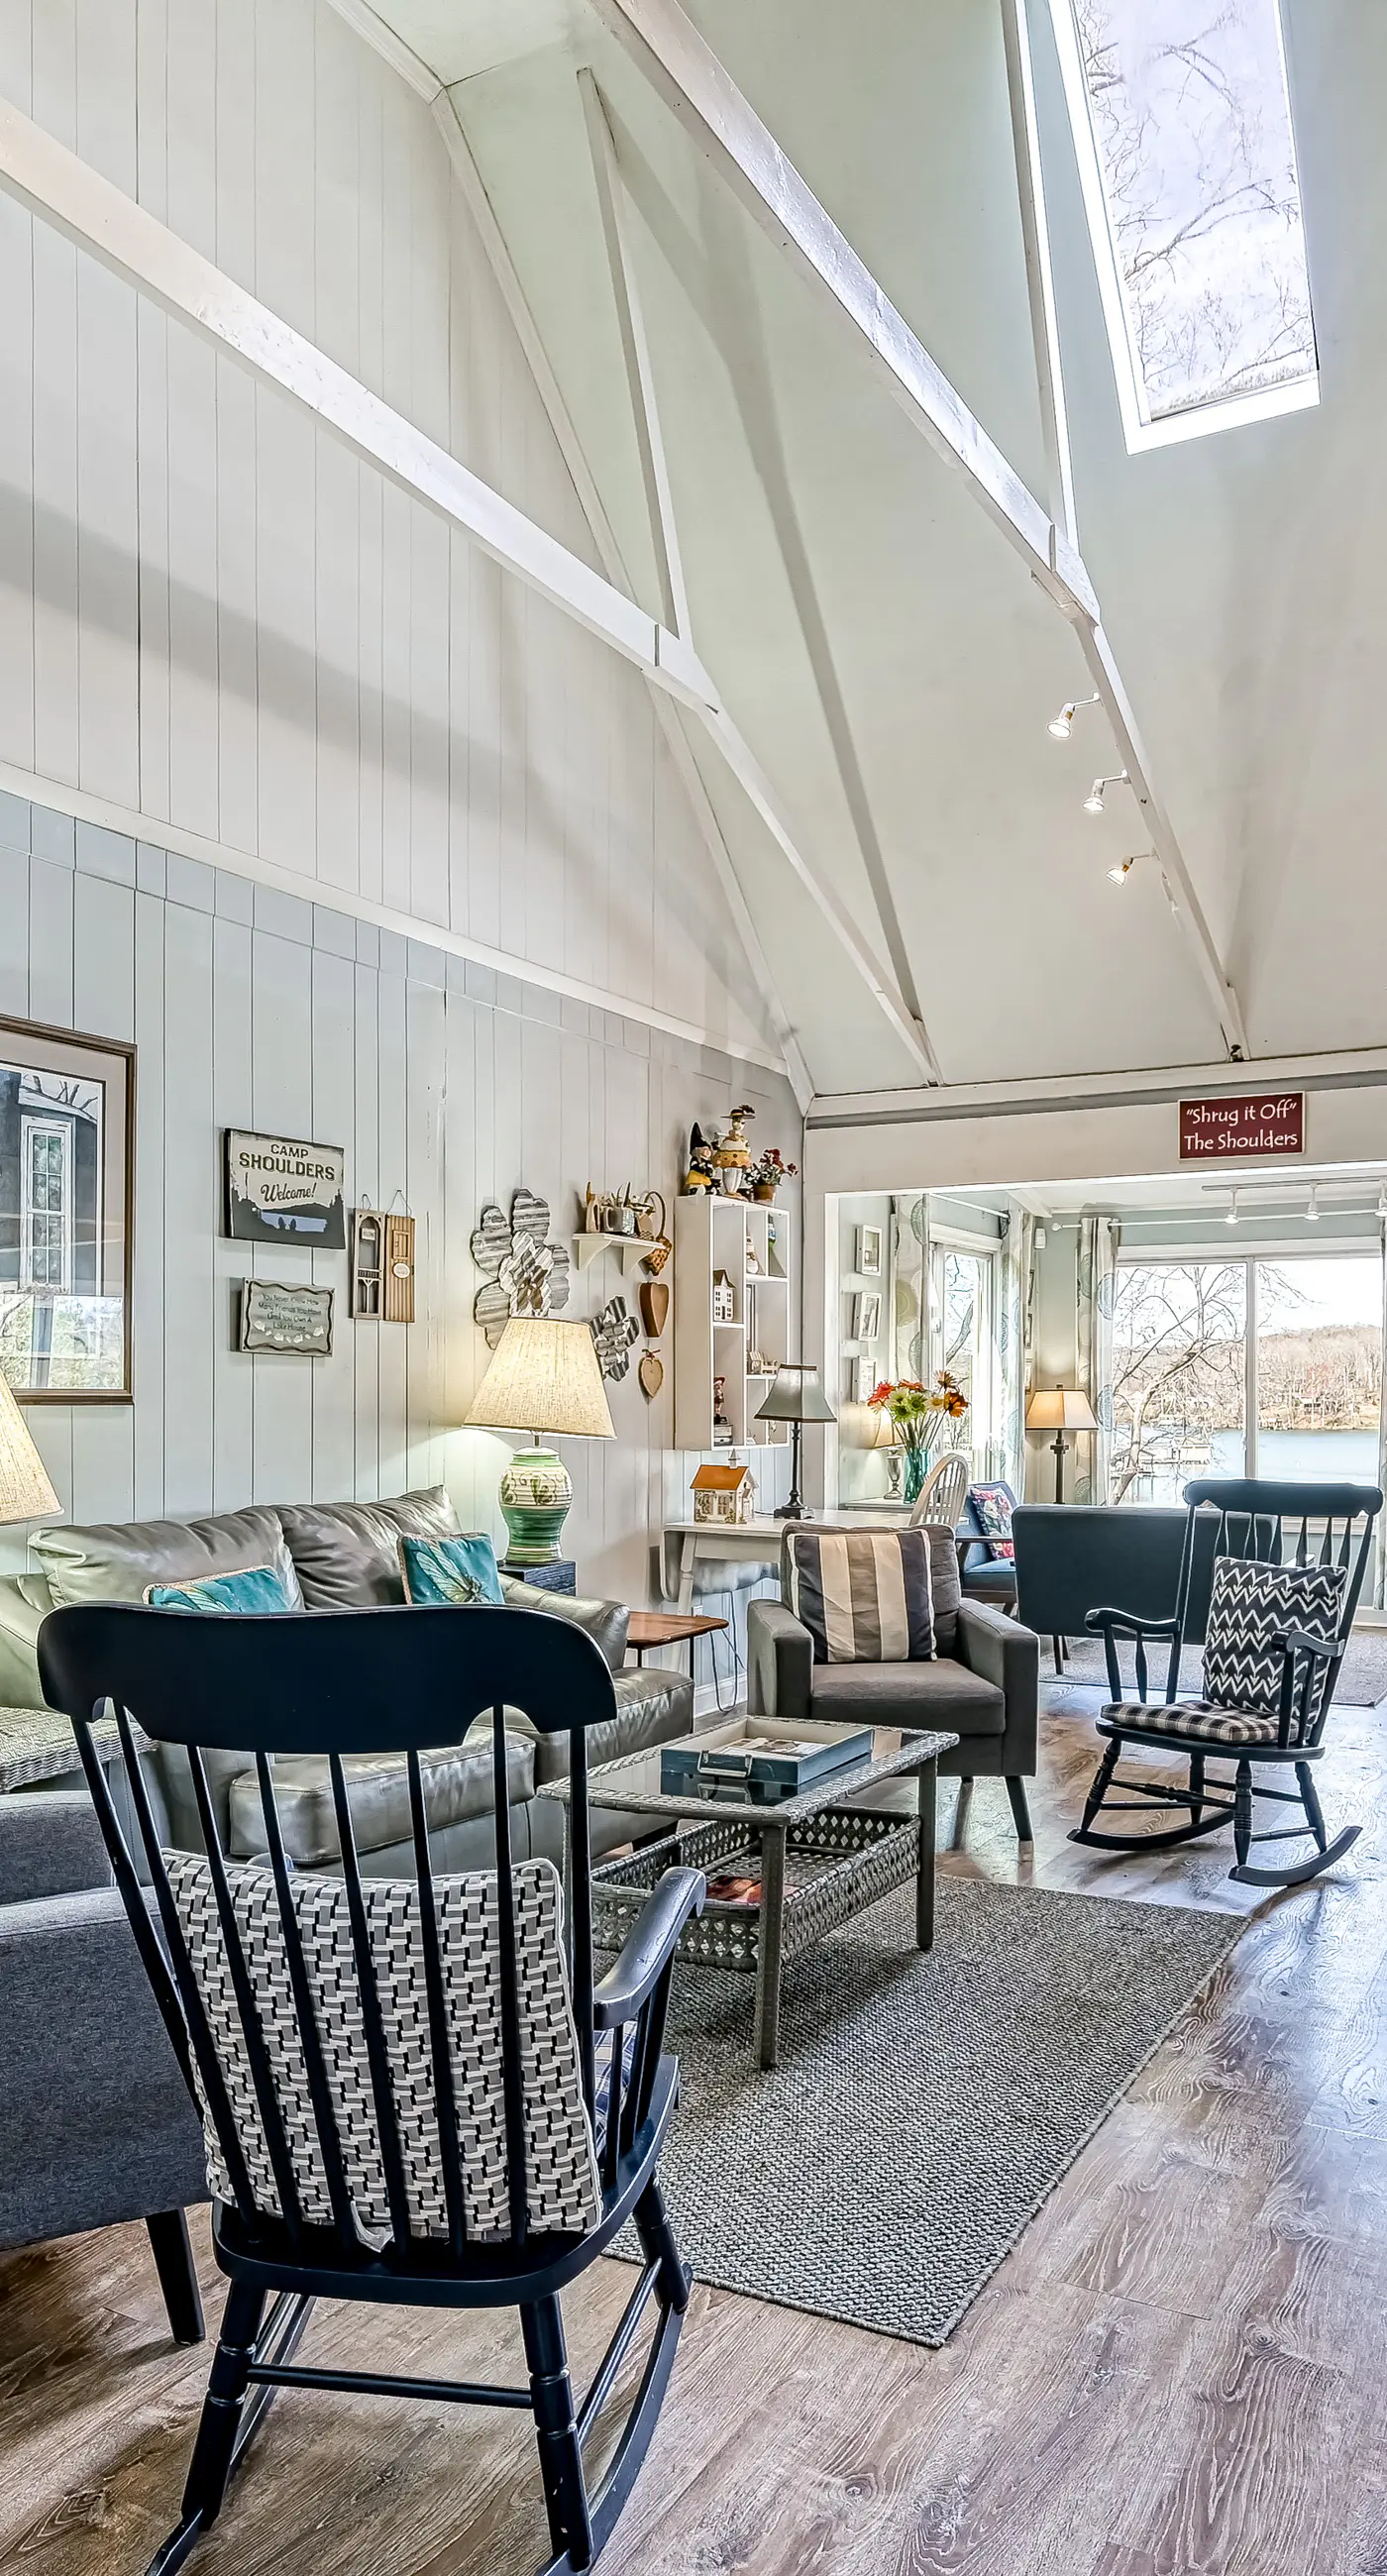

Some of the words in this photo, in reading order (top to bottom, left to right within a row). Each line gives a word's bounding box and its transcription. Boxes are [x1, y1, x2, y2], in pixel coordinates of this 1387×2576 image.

[1186, 1105, 1238, 1127] "Shrug
[1244, 1105, 1256, 1121] it
[1260, 1099, 1297, 1120] Off"
[1184, 1132, 1214, 1150] The
[1218, 1128, 1298, 1149] Shoulders
[270, 1143, 309, 1158] CAMP
[239, 1151, 335, 1181] SHOULDERS
[260, 1182, 317, 1202] Welcome!
